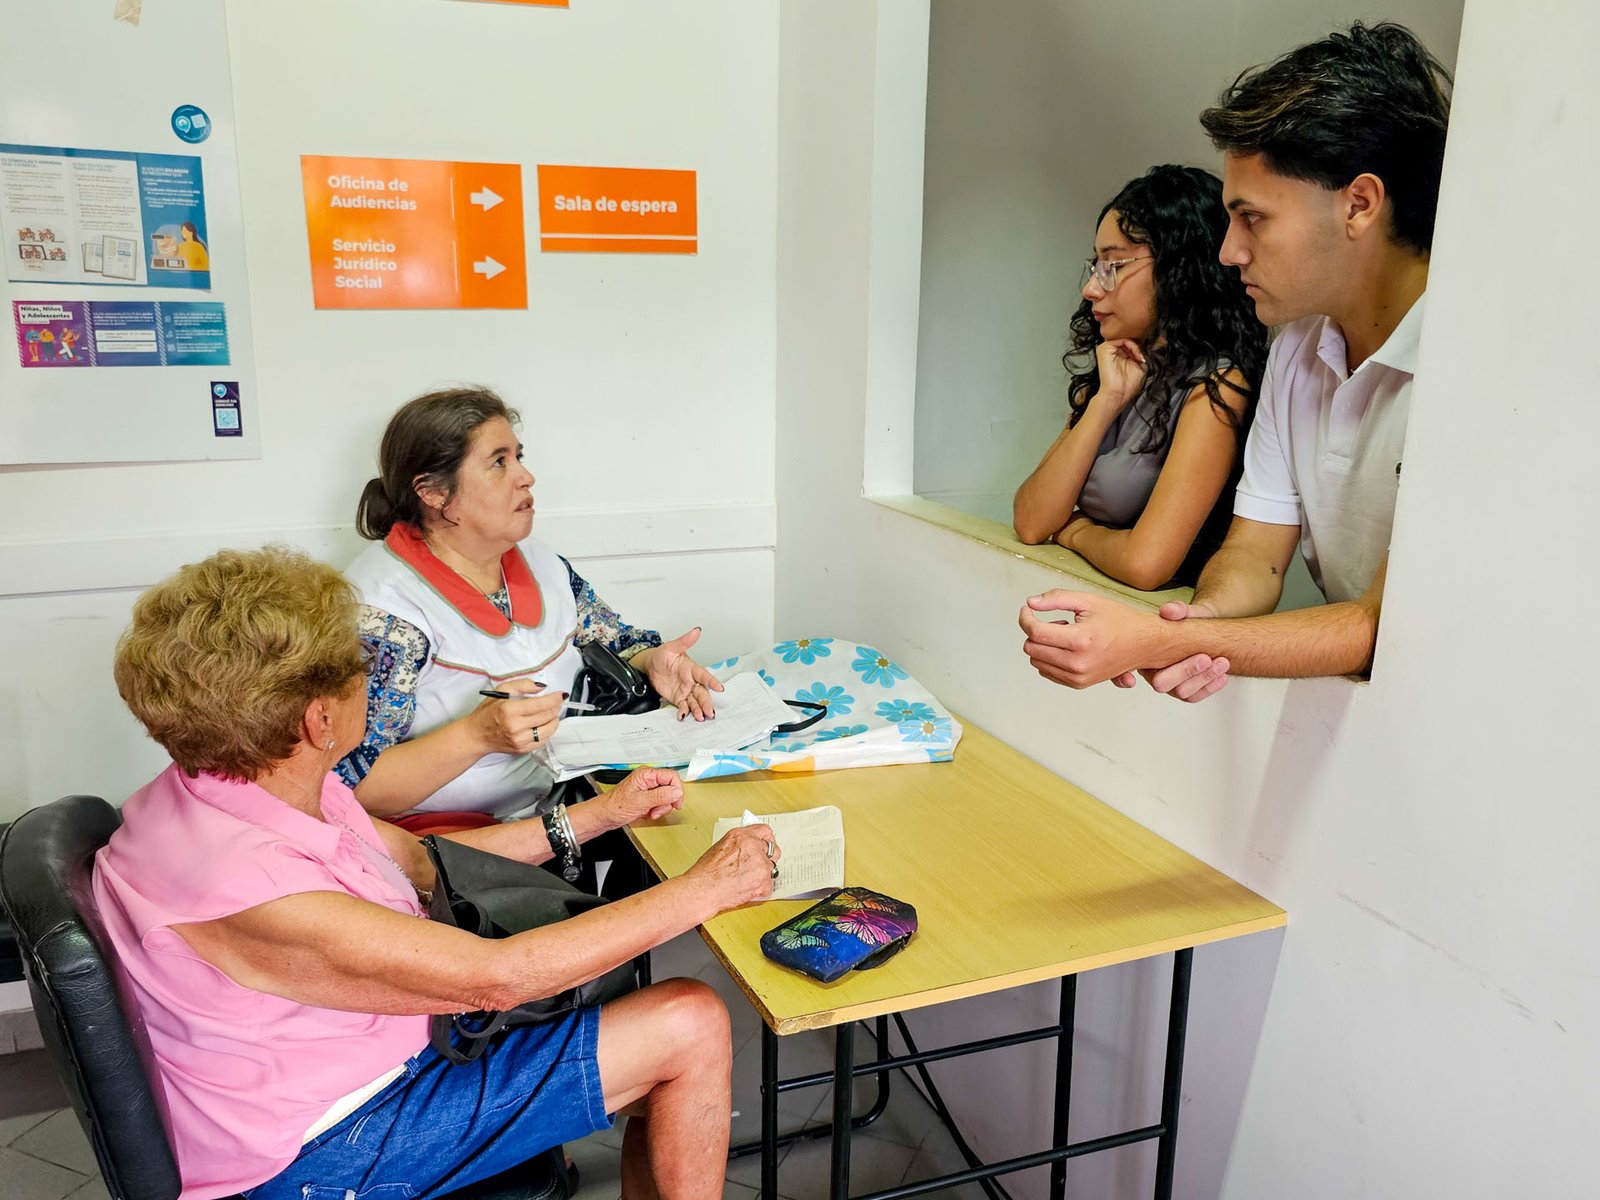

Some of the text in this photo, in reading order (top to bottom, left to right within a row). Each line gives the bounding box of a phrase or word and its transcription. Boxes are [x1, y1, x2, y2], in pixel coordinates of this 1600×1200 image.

[327, 175, 408, 192] Oficina de
[330, 194, 417, 211] Audiencias
[554, 194, 678, 216] Sala de espera
[332, 238, 396, 253] Servicio
[333, 256, 398, 271] Jurídico
[335, 274, 383, 289] Social
